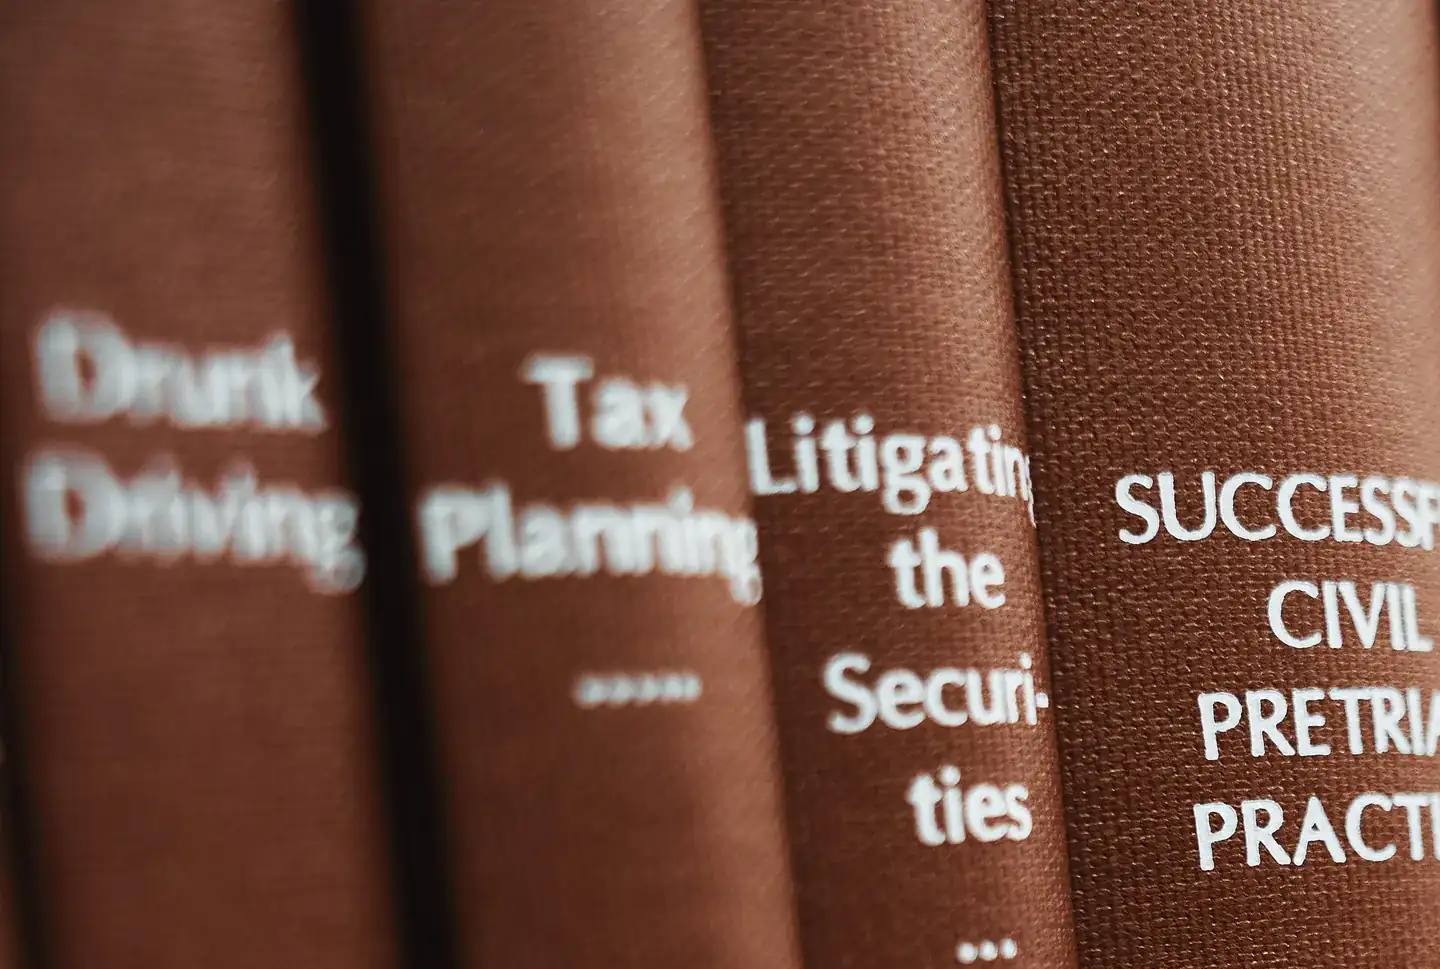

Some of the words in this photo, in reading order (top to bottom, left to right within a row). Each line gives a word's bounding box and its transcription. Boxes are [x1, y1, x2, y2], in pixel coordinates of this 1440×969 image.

[36, 313, 325, 430] Drunk
[522, 353, 694, 449] Tax
[26, 450, 363, 591] Driving
[419, 481, 761, 605] Planning
[889, 529, 1006, 609] the
[1267, 581, 1434, 652] CIVIL
[824, 651, 1049, 733] Securi-
[906, 766, 1032, 845] ties
